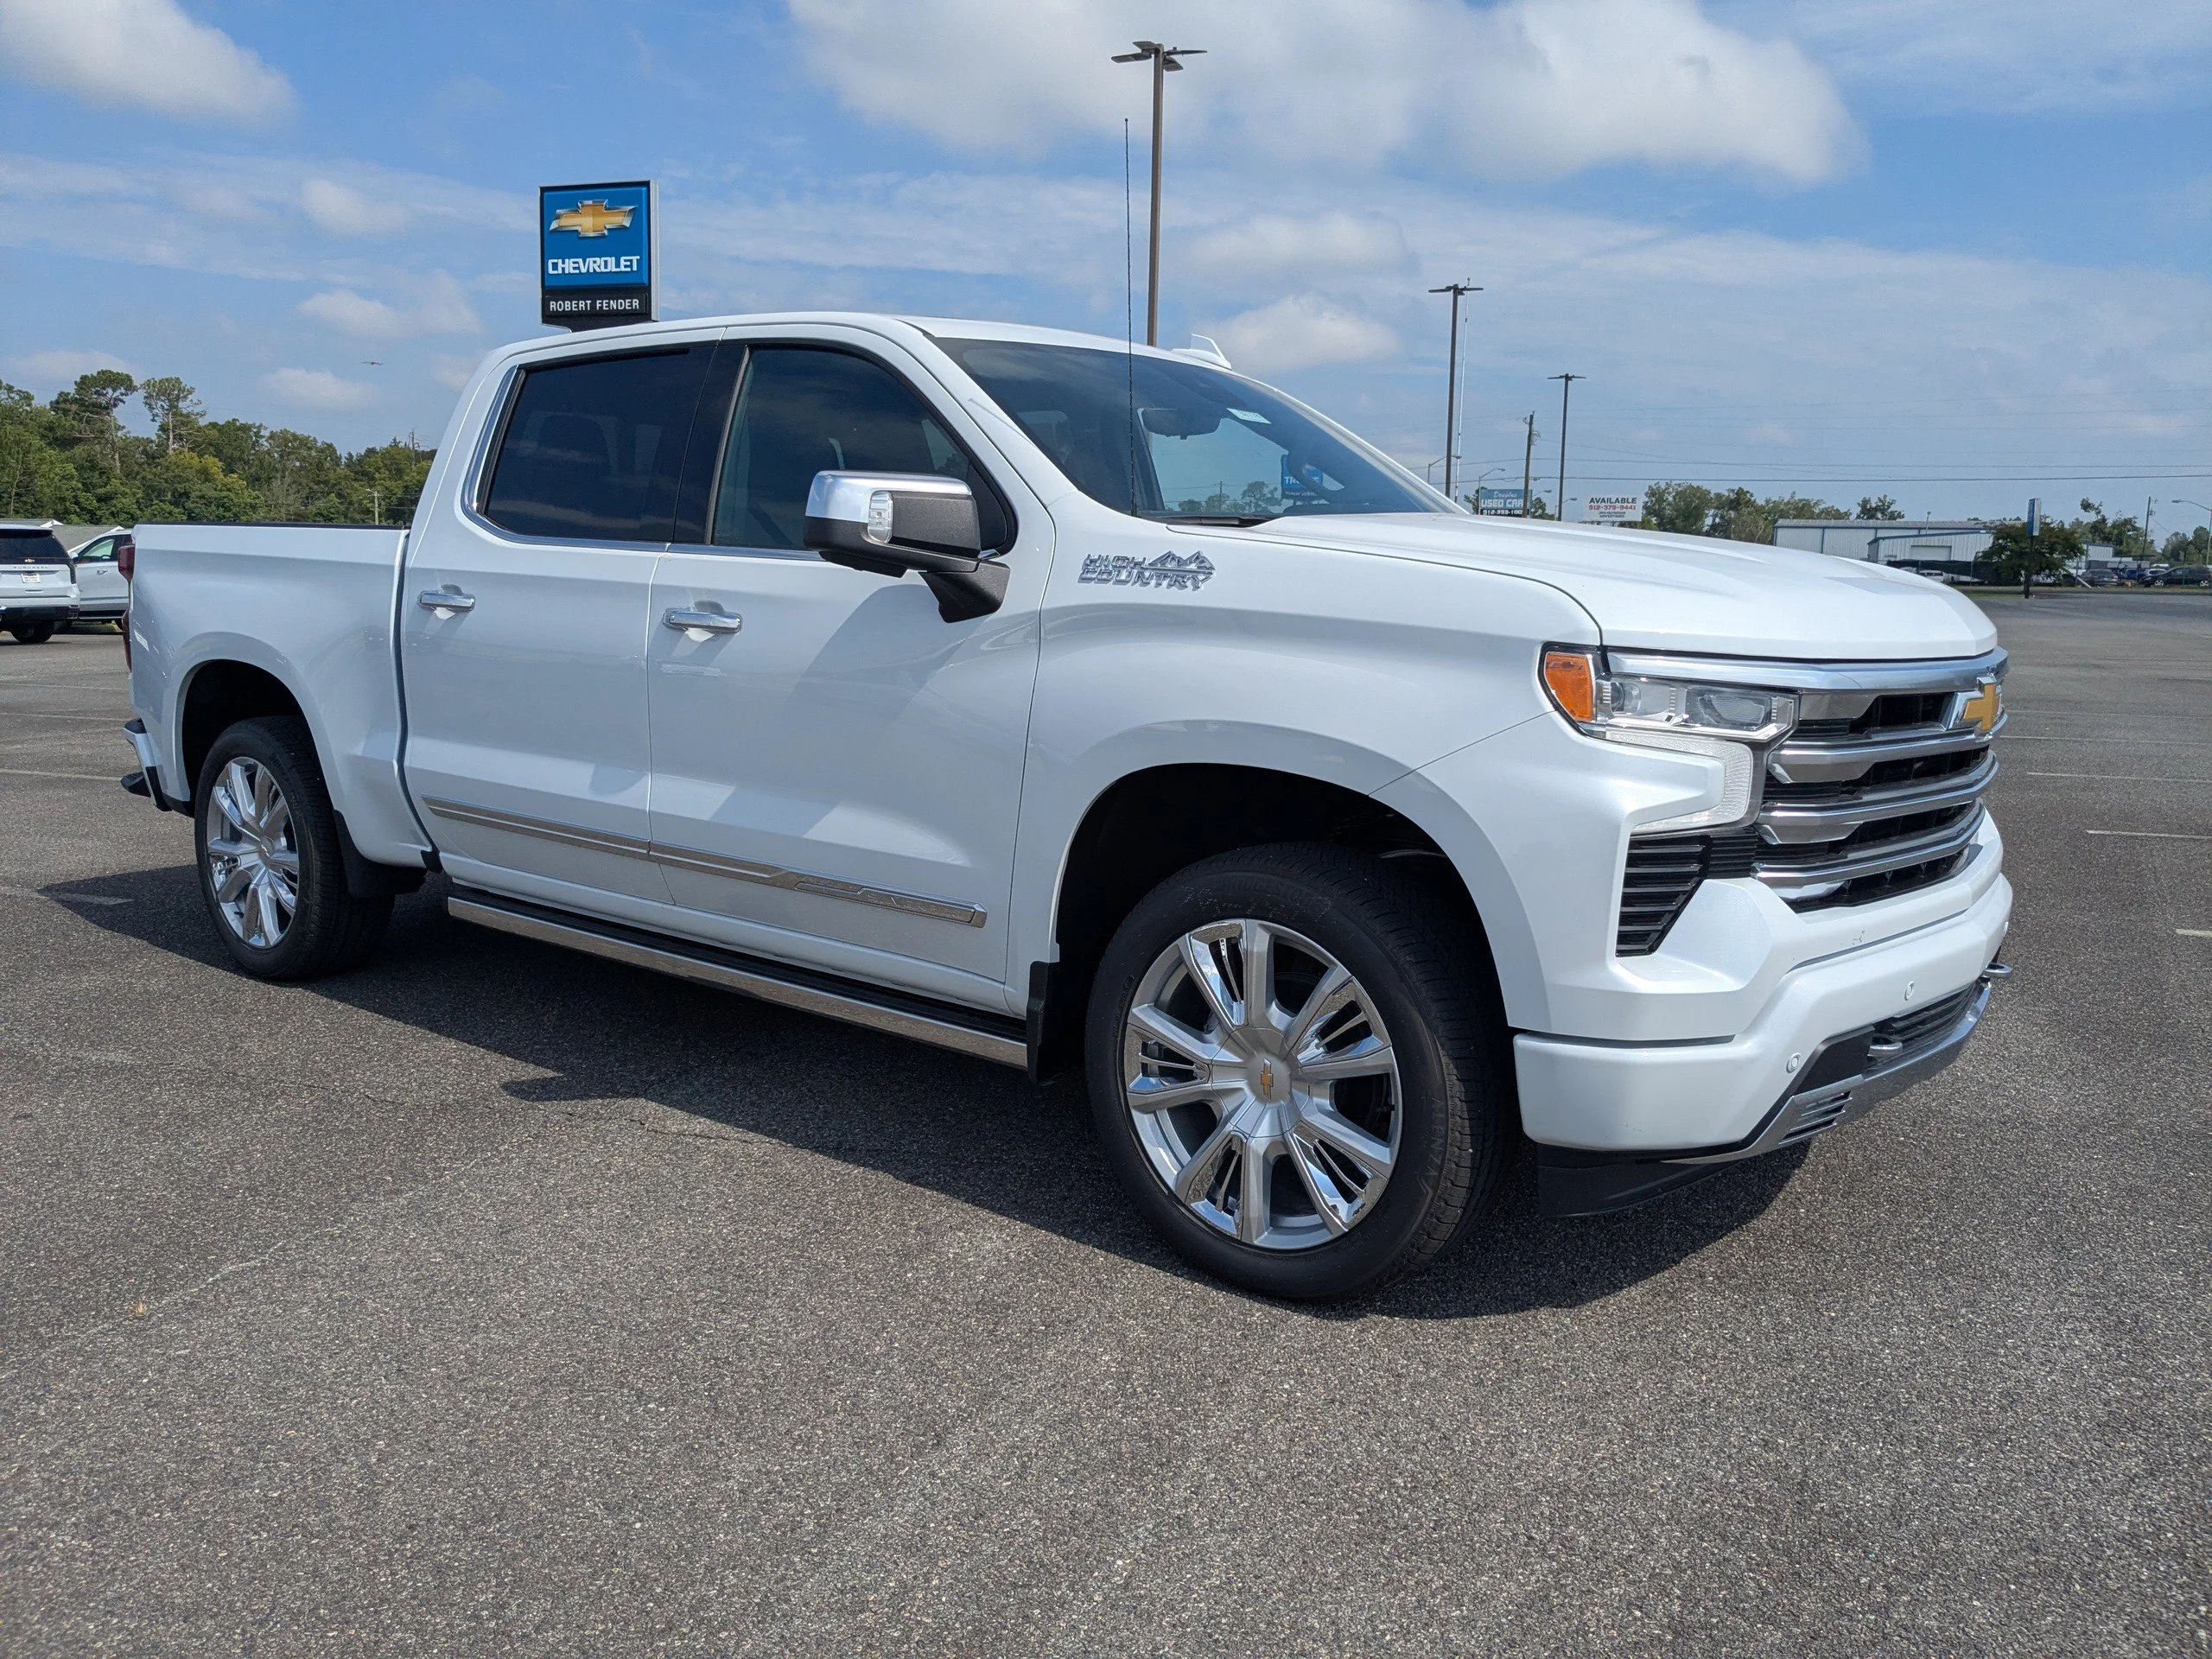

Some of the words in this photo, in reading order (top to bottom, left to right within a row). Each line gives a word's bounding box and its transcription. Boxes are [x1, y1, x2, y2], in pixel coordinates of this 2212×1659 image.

[548, 256, 640, 275] CHEVROLET
[550, 300, 592, 312] ROBERT
[596, 299, 639, 311] FENDER
[1481, 499, 1503, 508] USED
[1505, 499, 1527, 508] CAR
[1081, 553, 1148, 569] HIGH
[1077, 567, 1204, 592] COUNTRY
